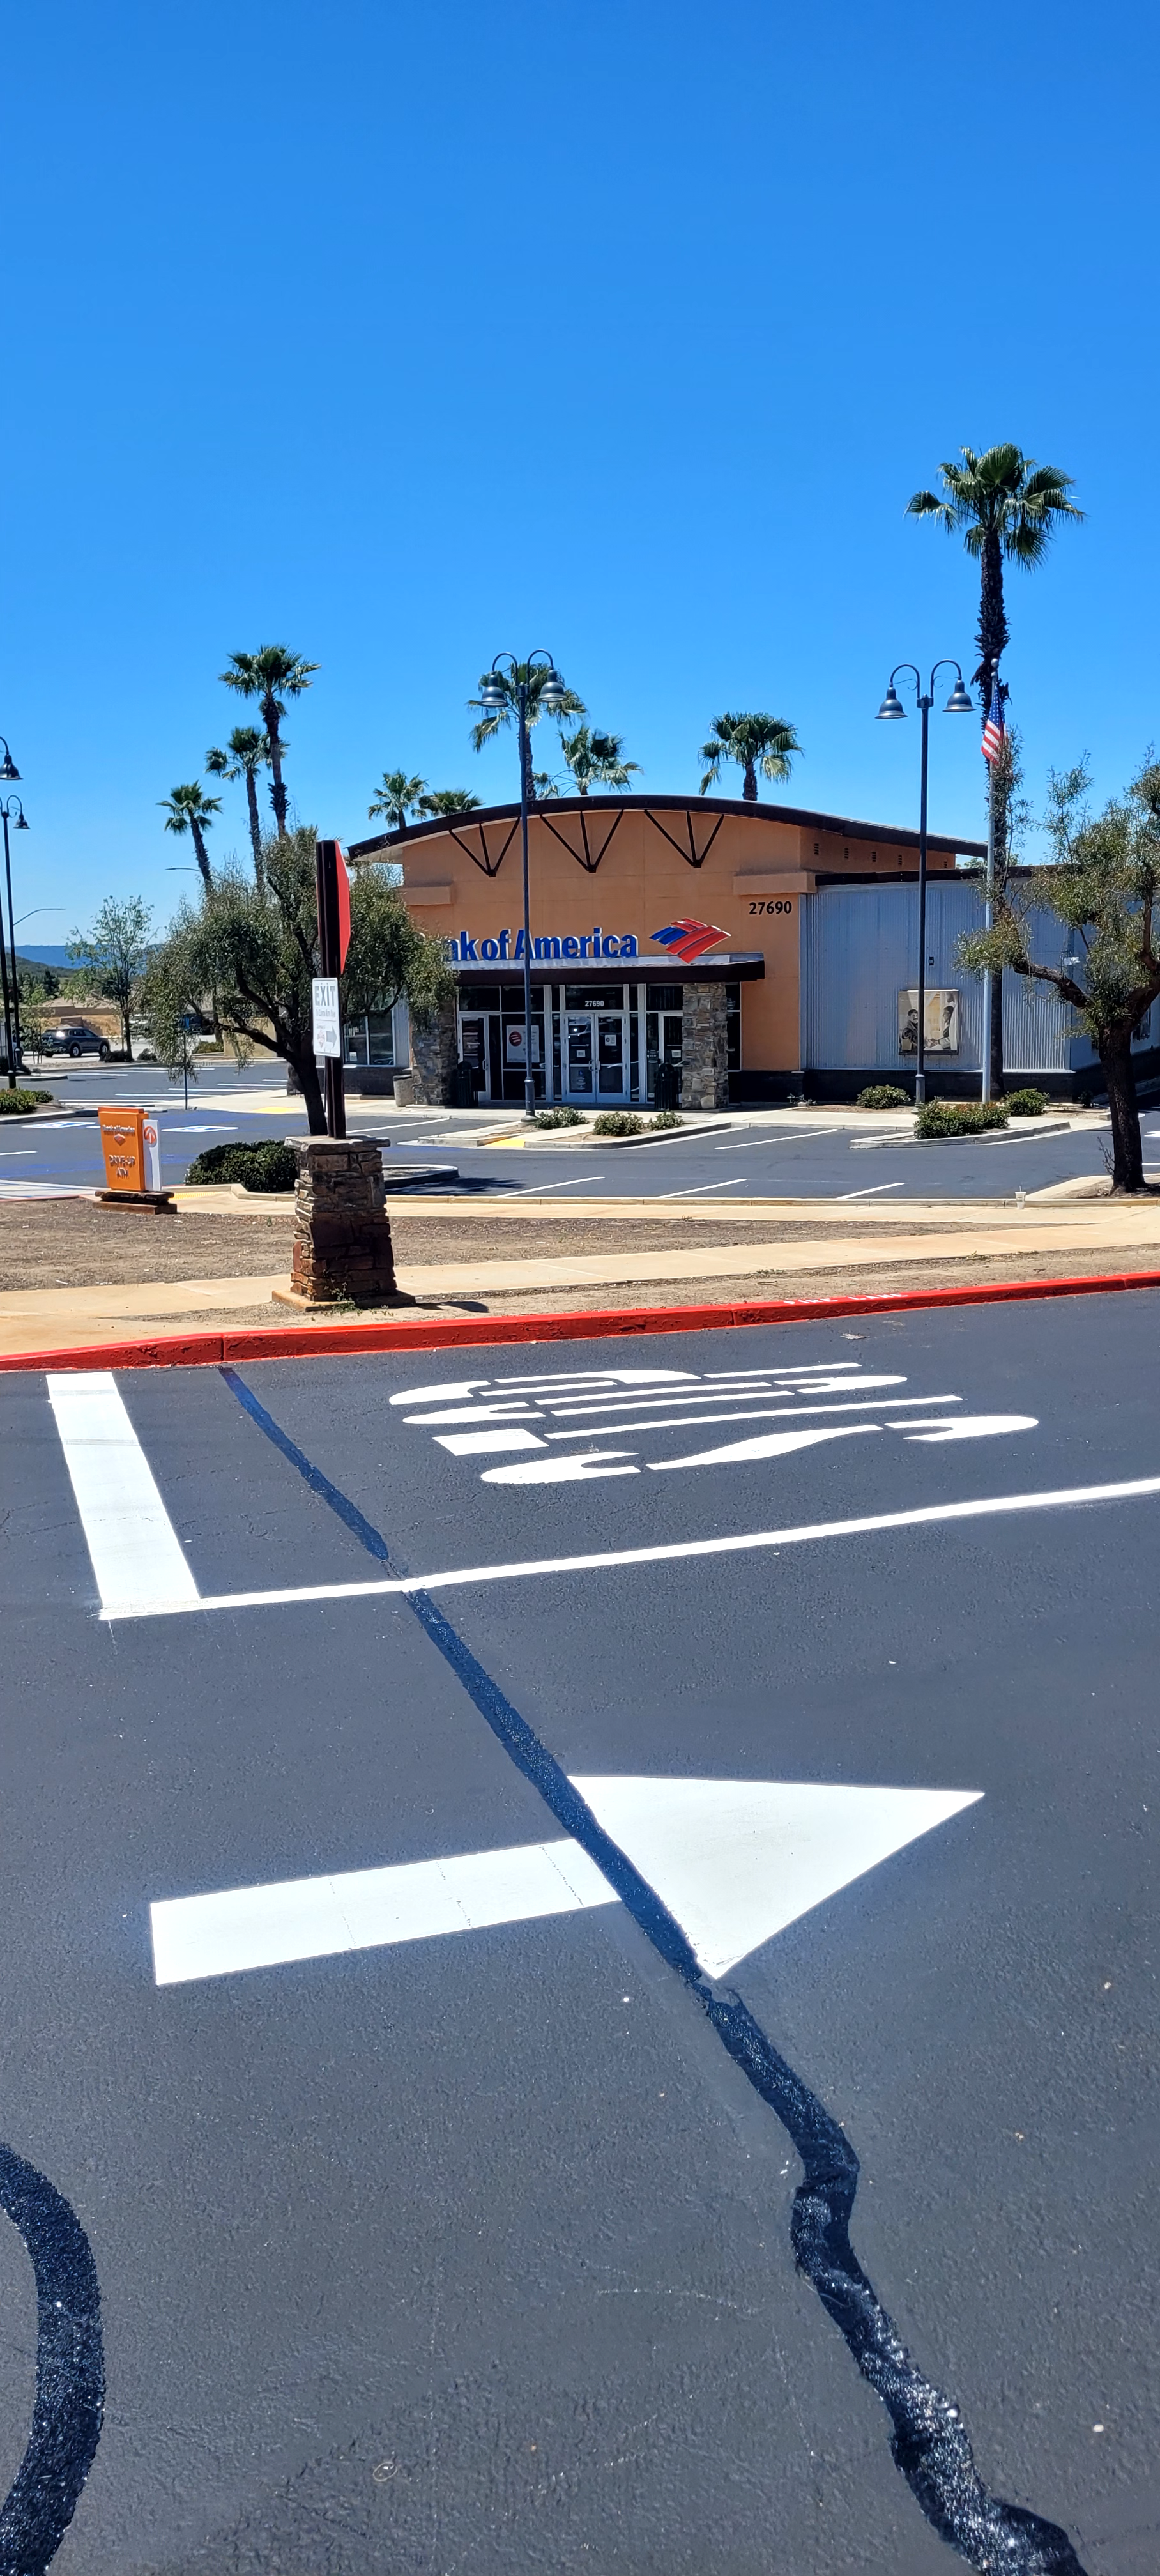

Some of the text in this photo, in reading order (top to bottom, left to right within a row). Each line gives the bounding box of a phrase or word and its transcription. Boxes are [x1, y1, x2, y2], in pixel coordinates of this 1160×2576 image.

[749, 900, 792, 916] 27690
[481, 928, 512, 960] of
[514, 927, 638, 960] America
[314, 985, 336, 1007] EXIT
[388, 1362, 1039, 1484] STOP
